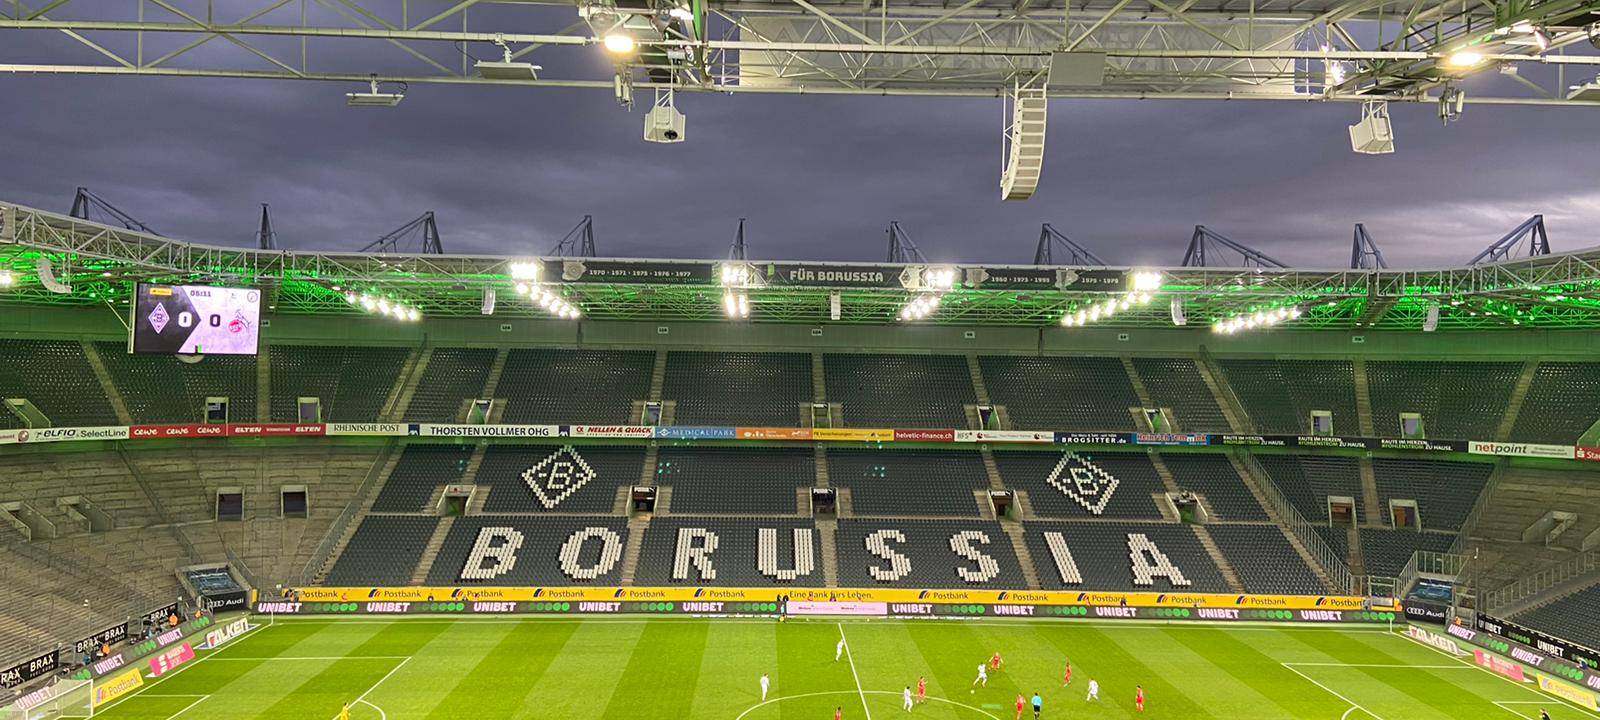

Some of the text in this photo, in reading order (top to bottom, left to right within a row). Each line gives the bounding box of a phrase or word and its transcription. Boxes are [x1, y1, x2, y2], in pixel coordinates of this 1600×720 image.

[789, 268, 884, 282] FÜR BORUSSIA
[190, 290, 212, 298] 05:11
[178, 311, 192, 328] 0
[210, 314, 221, 328] 0
[333, 424, 400, 432] RHEINISCHE POST
[431, 427, 549, 436] THORSTEN VOLLMER OHG
[712, 429, 735, 437] PARK
[80, 429, 127, 439] SelectLine
[1474, 443, 1527, 455] netpoint
[461, 526, 1192, 586] BORUSSIA
[384, 590, 422, 598] Postbank
[467, 590, 504, 599] Postbank
[548, 590, 585, 598] Postbank
[629, 590, 666, 599] Postbank
[709, 590, 745, 599] Postbank
[789, 591, 807, 599] Eine
[933, 592, 969, 600] Postbank
[1013, 593, 1048, 602] Postbank
[225, 598, 244, 606] Audi
[1171, 596, 1207, 604] Postbank
[1251, 597, 1286, 605] Postbank
[258, 602, 302, 613] UNIBET
[366, 602, 411, 612] UNIBET
[473, 601, 516, 612] UNIBET
[578, 602, 621, 612] UNIBET
[683, 602, 724, 612] UNIBET
[892, 603, 932, 613] UNIBET
[993, 605, 1034, 615] UNIBET
[150, 608, 169, 623] BRAX
[1095, 607, 1137, 617] UNIBET
[1198, 608, 1239, 619] UNIBET
[1300, 610, 1342, 620] UNIBET
[1425, 610, 1446, 619] Audi
[105, 625, 125, 641] BRAX
[156, 628, 183, 646] UNIBET
[206, 617, 250, 647] FALKEN
[1447, 623, 1477, 641] UNIBET
[77, 636, 99, 653] BRAX
[1408, 625, 1460, 656] FALKEN
[1537, 639, 1565, 657] UNIBET
[1511, 646, 1545, 667] UNIBET
[29, 653, 54, 672] BRAX
[93, 653, 125, 675] UNIBET
[108, 674, 140, 697] Postbank
[14, 685, 53, 711] UNIBET
